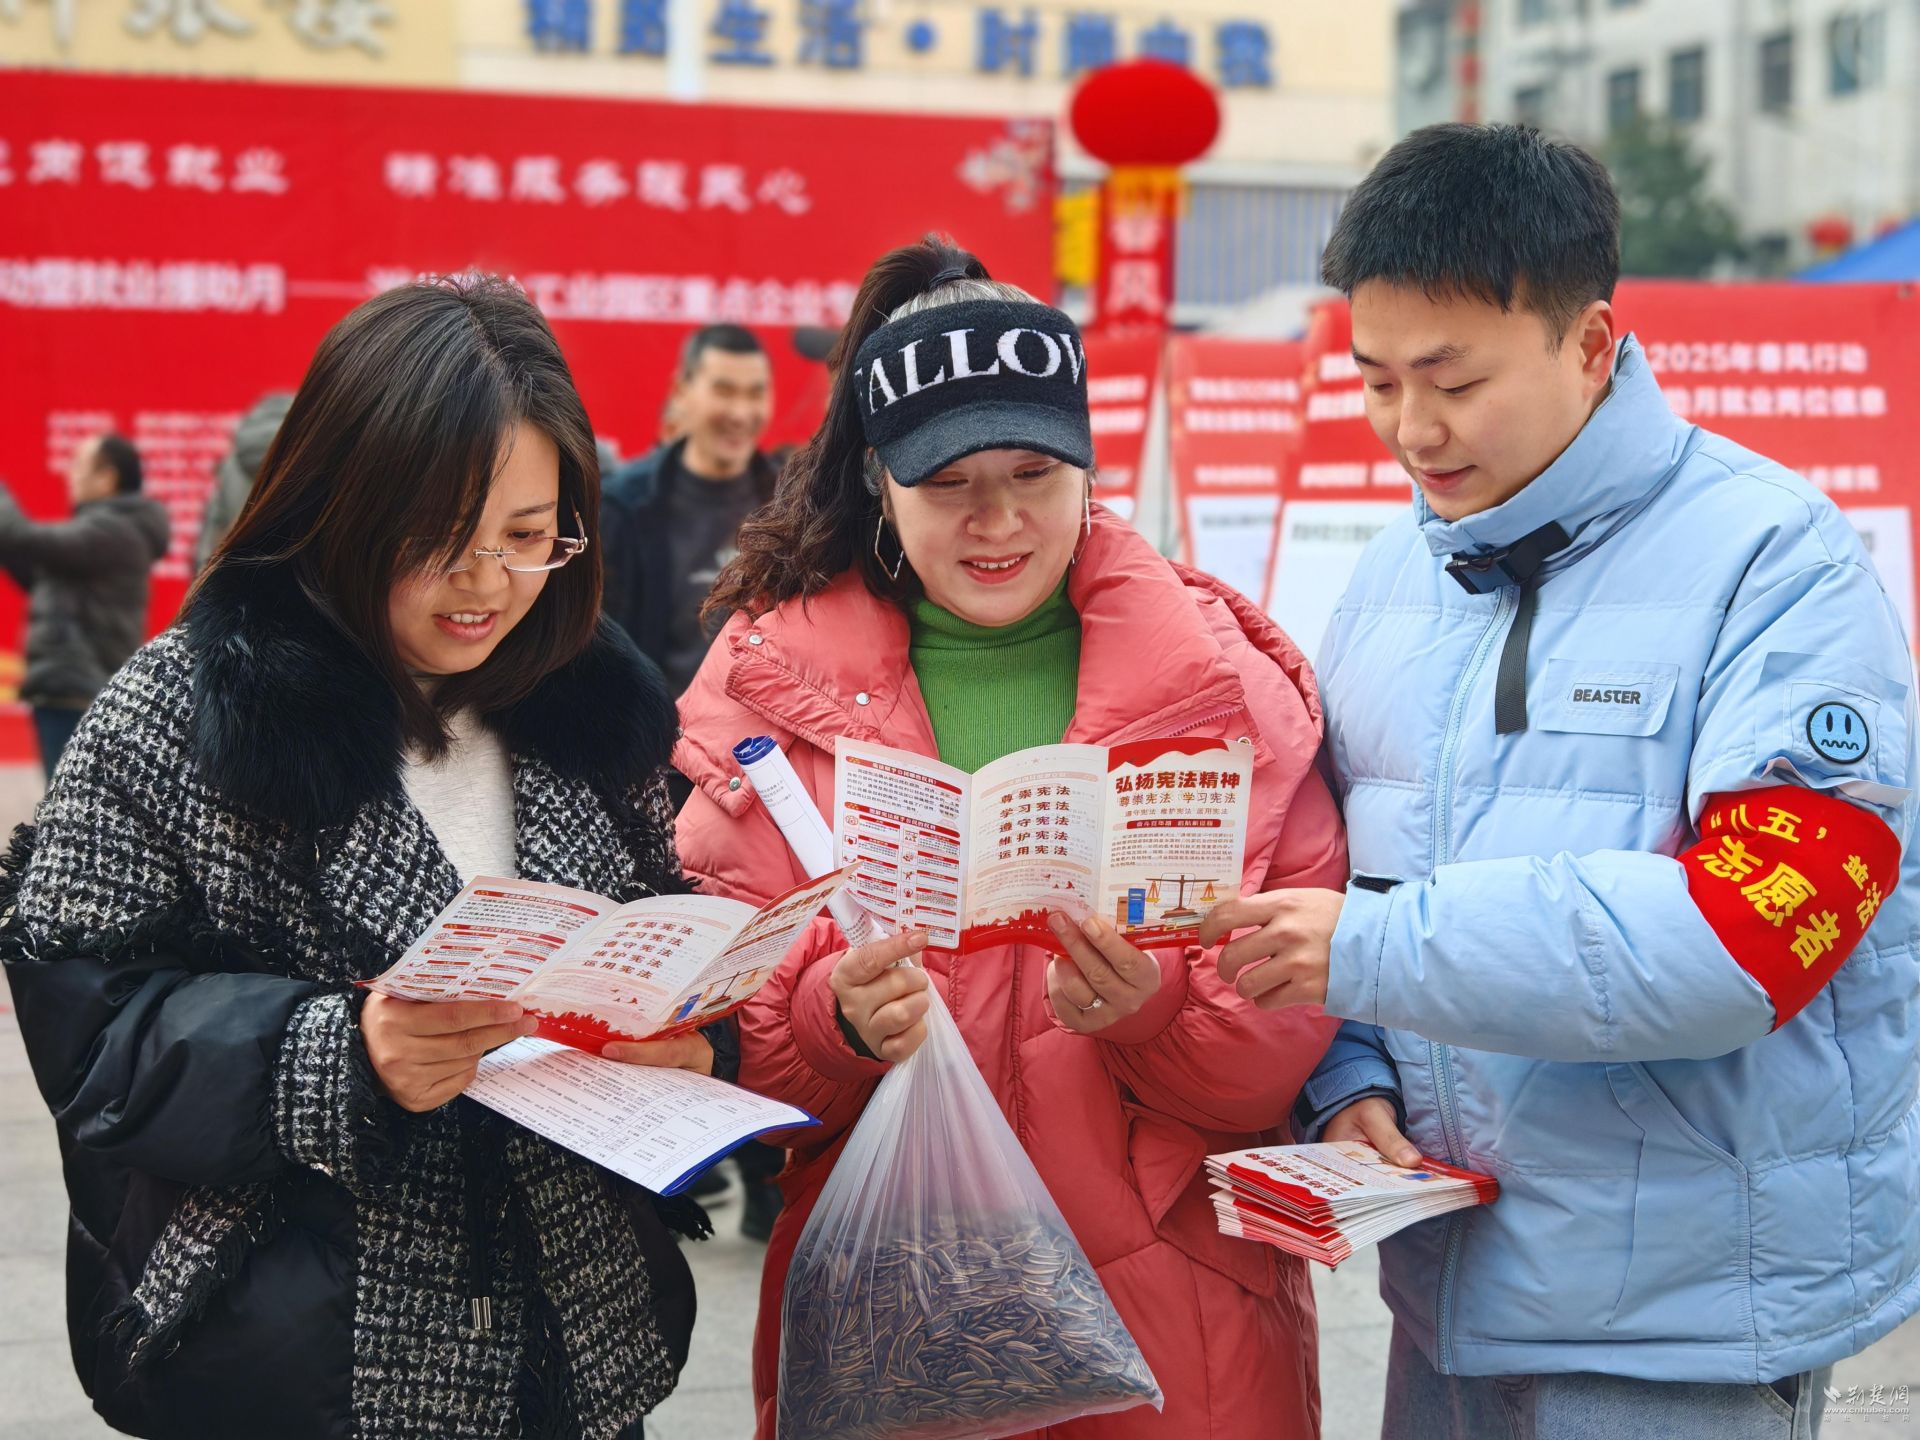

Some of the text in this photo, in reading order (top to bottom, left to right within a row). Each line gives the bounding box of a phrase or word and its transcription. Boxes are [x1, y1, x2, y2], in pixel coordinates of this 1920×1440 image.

[855, 327, 1086, 416] ALLOW
[1573, 688, 1642, 705] BEASTER
[1115, 771, 1240, 794] 弘扬宪法精神
[1001, 785, 1071, 804] 尊崇宪法
[1119, 792, 1236, 808] 尊崇宪法 学习宪法
[1000, 801, 1070, 819] 学习宪法
[1000, 816, 1069, 833] 遵守宪法
[998, 830, 1068, 846] 维护宪法
[998, 845, 1068, 860] 运用宪法
[1697, 834, 1841, 970] 志愿者
